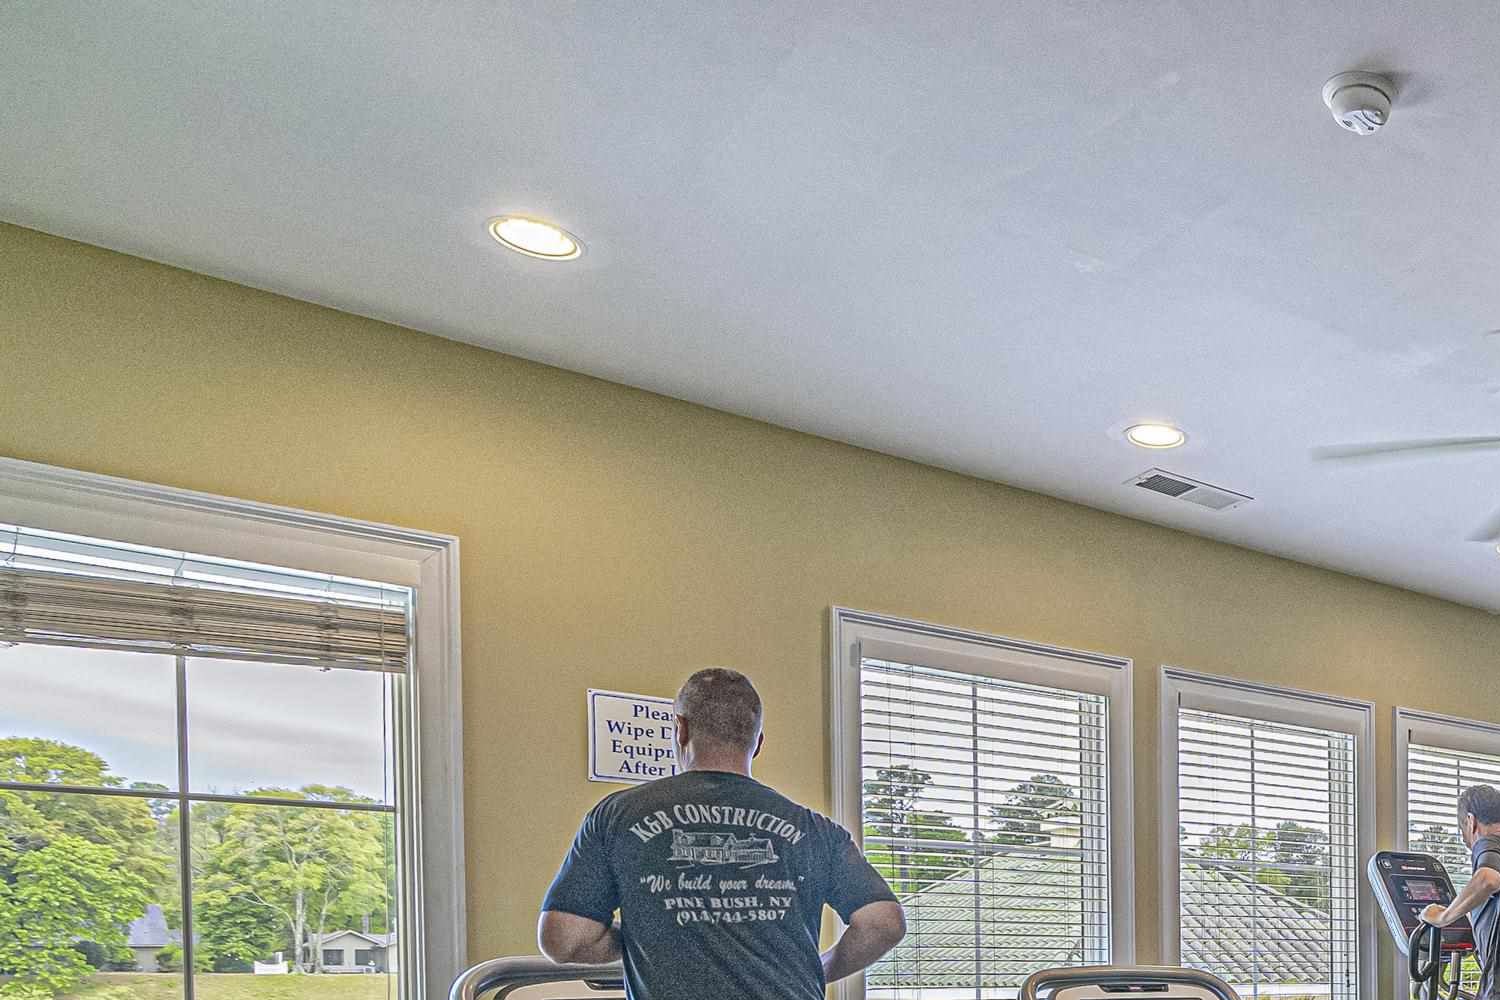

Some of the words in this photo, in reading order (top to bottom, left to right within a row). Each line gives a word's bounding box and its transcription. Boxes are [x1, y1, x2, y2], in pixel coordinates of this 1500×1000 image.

[633, 704, 674, 721] Plea
[606, 720, 654, 740] Wipe
[612, 740, 675, 762] Equip
[619, 760, 666, 777] After
[630, 810, 674, 843] K&B
[673, 803, 806, 845] CONSTRUCTION
[678, 872, 712, 891] build
[719, 879, 747, 895] your
[664, 896, 706, 910] PINE
[769, 896, 793, 909] NY
